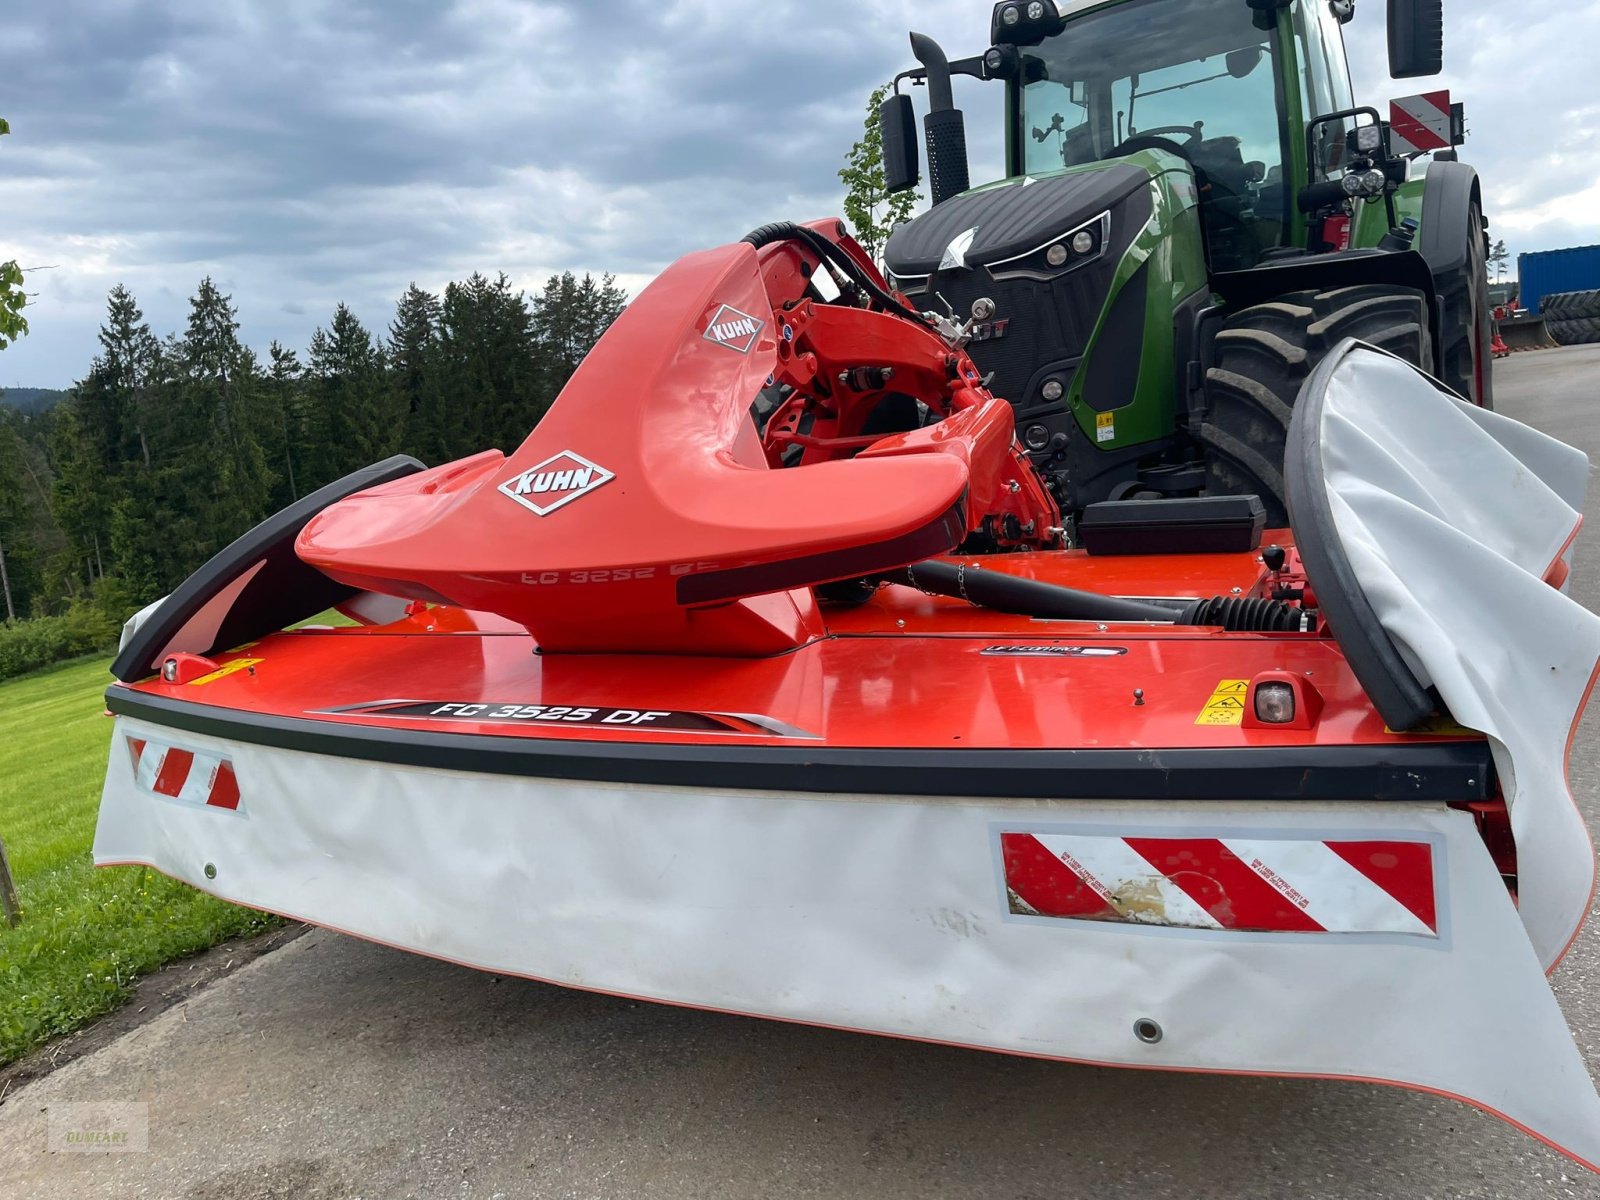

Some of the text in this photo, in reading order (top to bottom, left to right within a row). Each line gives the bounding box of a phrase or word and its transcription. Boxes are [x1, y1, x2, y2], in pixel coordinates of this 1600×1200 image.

[712, 318, 756, 341] KUHN
[514, 467, 594, 495] KUHN
[430, 703, 671, 724] FC 3525 DF
